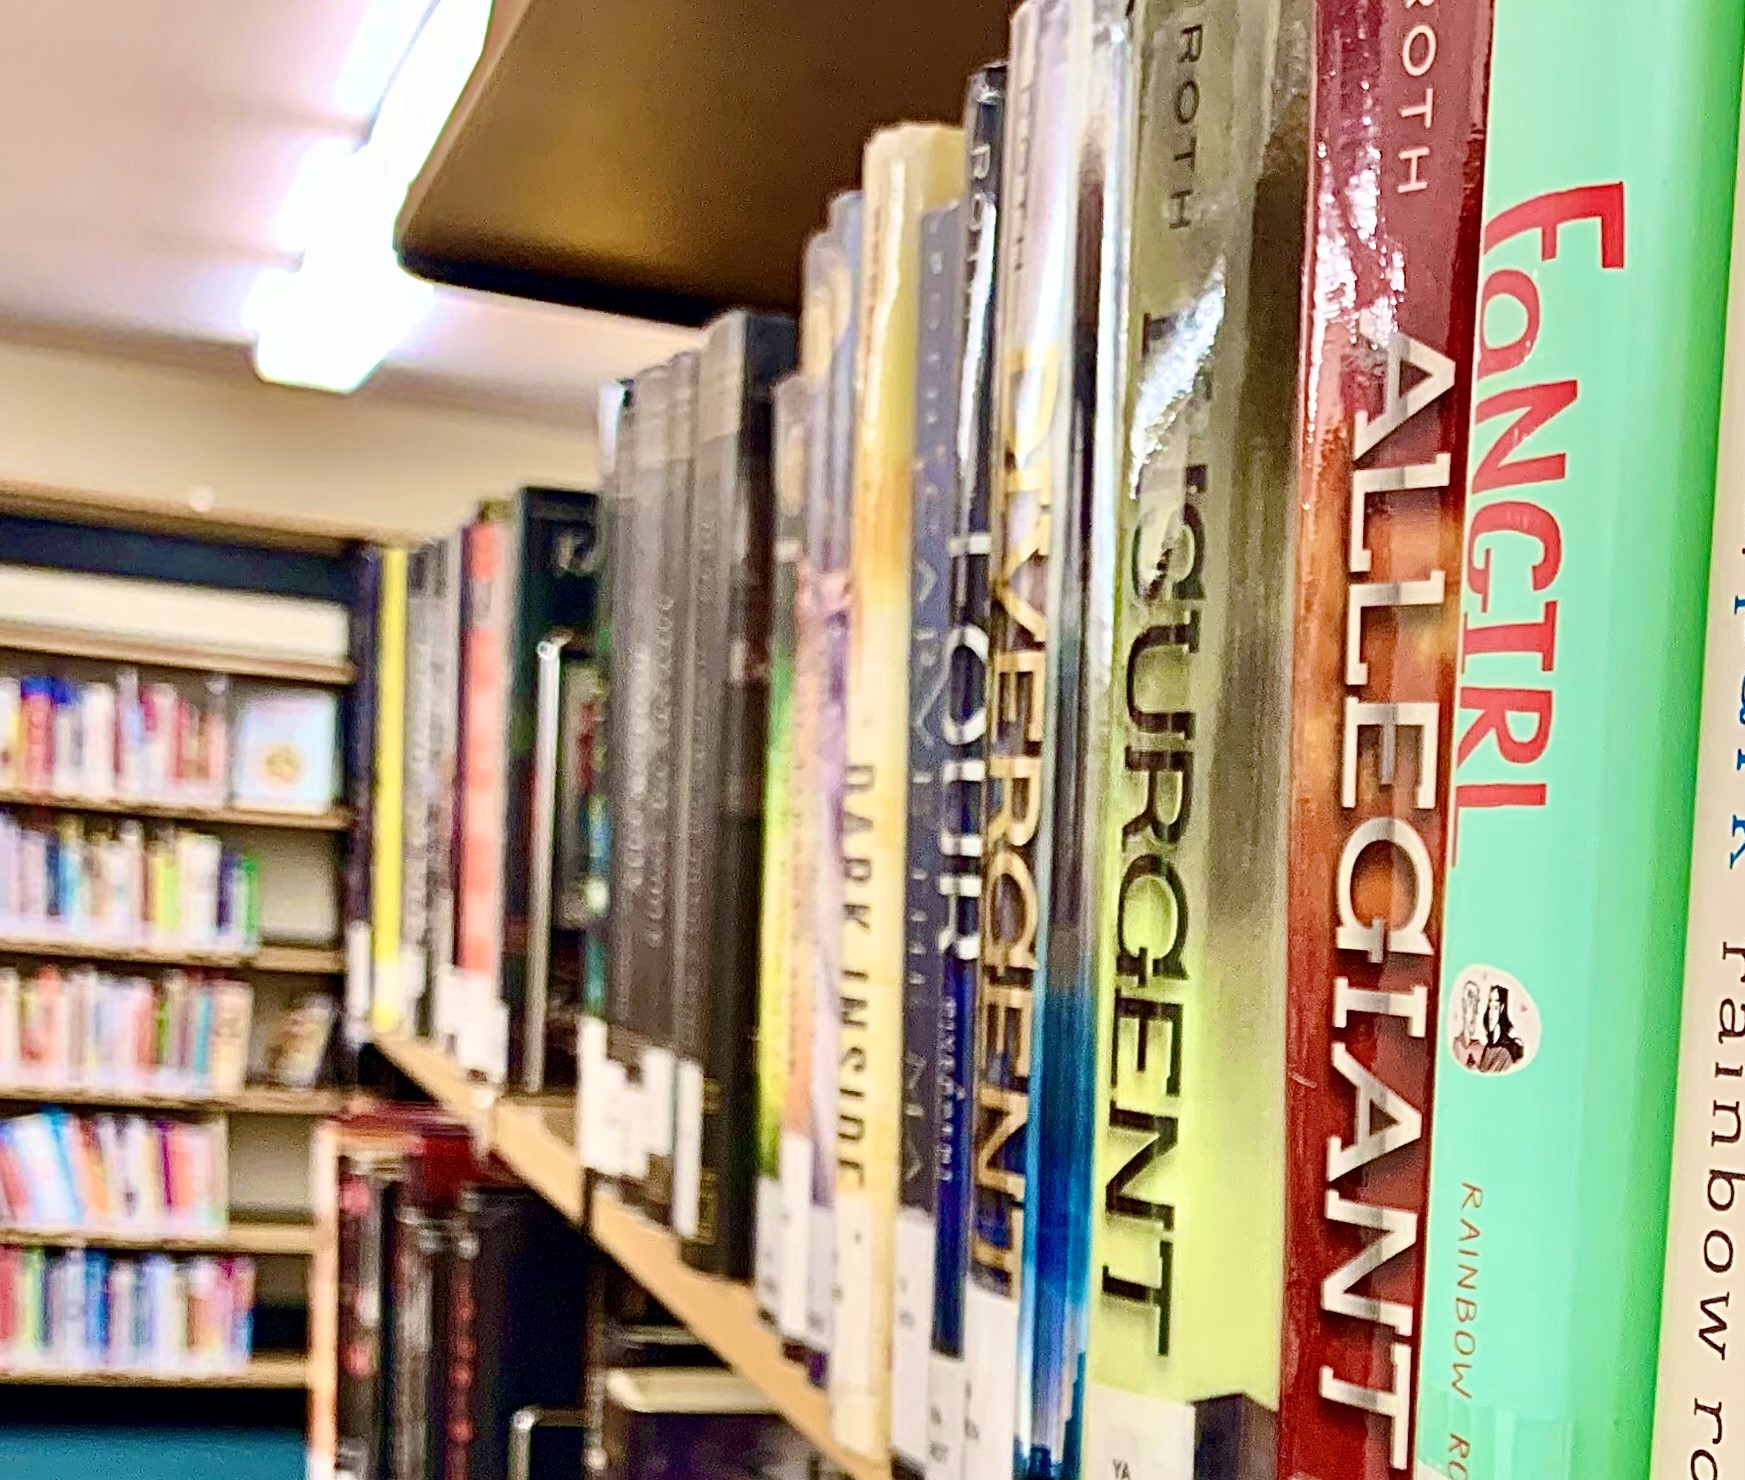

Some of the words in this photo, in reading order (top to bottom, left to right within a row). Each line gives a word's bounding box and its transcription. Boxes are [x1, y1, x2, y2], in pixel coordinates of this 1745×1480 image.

[1168, 24, 1204, 230] ROTH
[841, 763, 878, 934] DARK
[1318, 318, 1457, 1473] ALLEGIANT
[1450, 1182, 1483, 1399] RAINBOW
